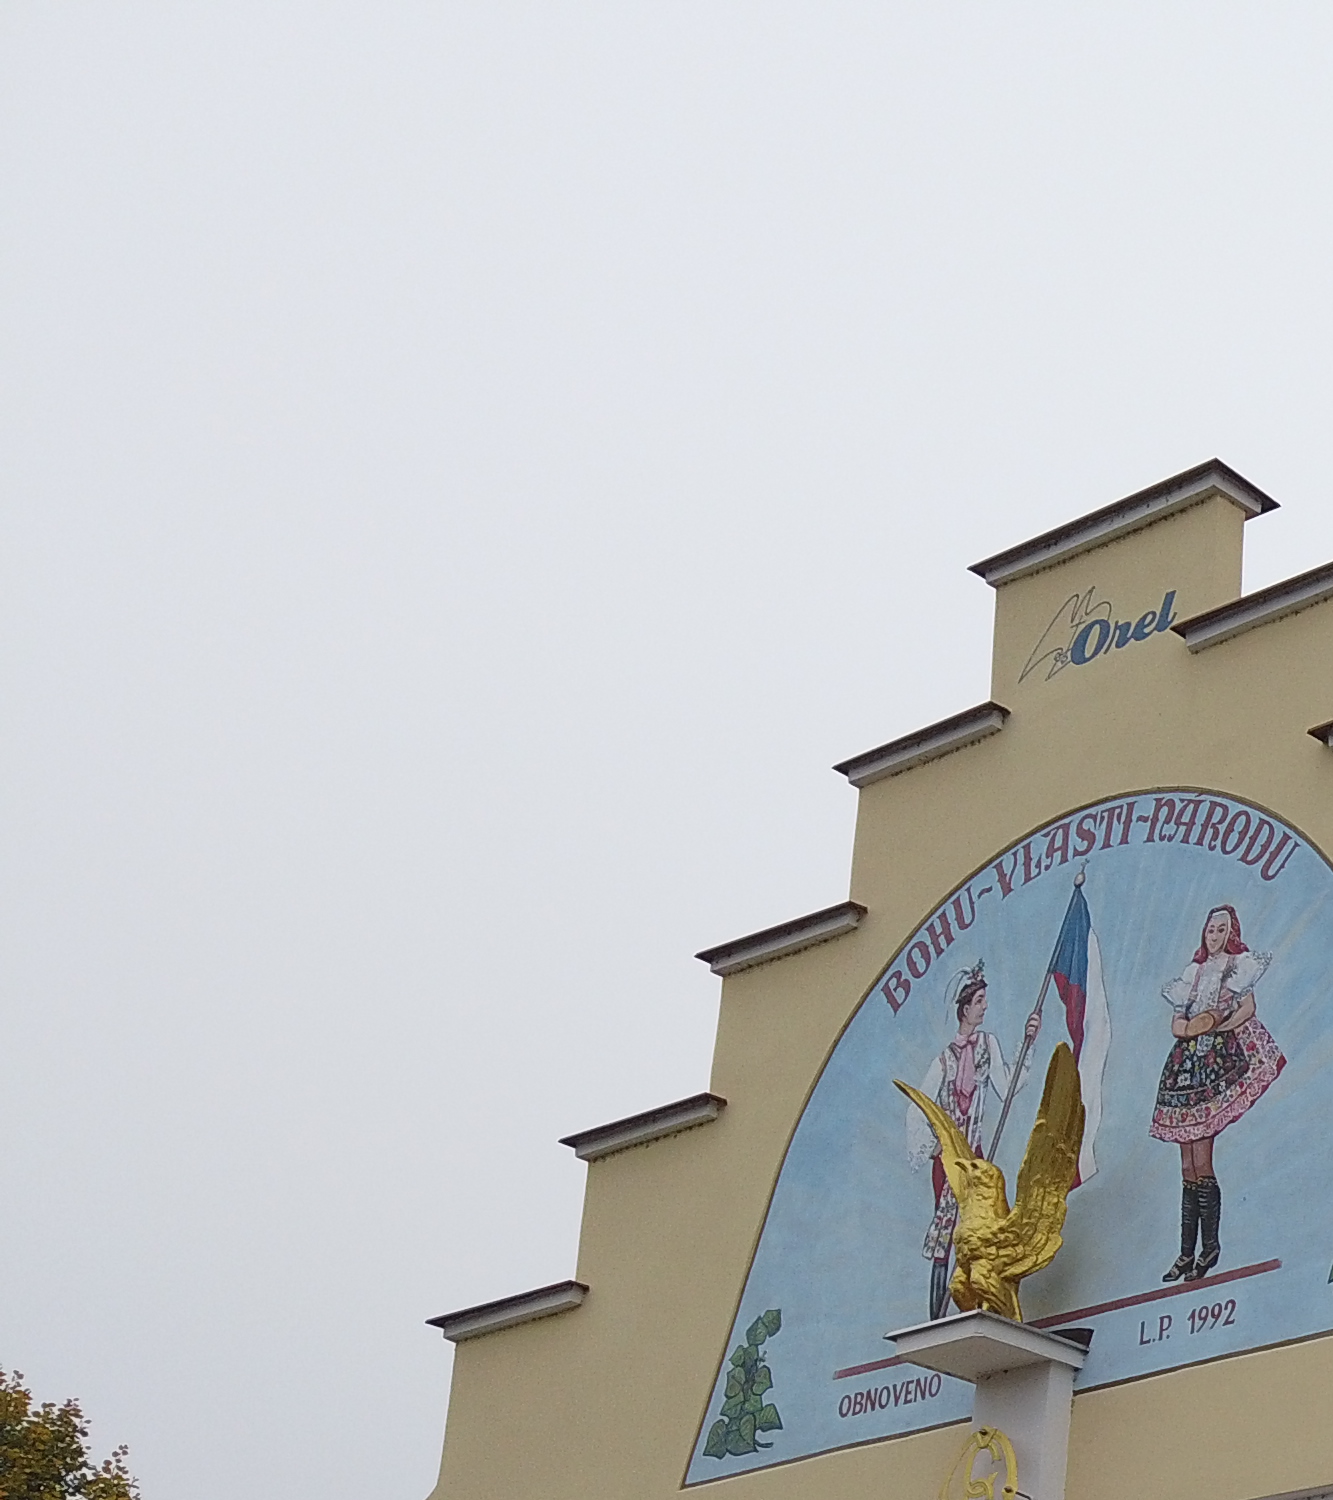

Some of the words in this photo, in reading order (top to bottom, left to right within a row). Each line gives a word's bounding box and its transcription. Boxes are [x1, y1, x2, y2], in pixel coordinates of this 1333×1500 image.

[1070, 589, 1178, 666] Orel
[838, 1373, 942, 1418] OBNOVENO
[1139, 1314, 1173, 1346] L.P.
[1187, 1299, 1237, 1335] 1992
